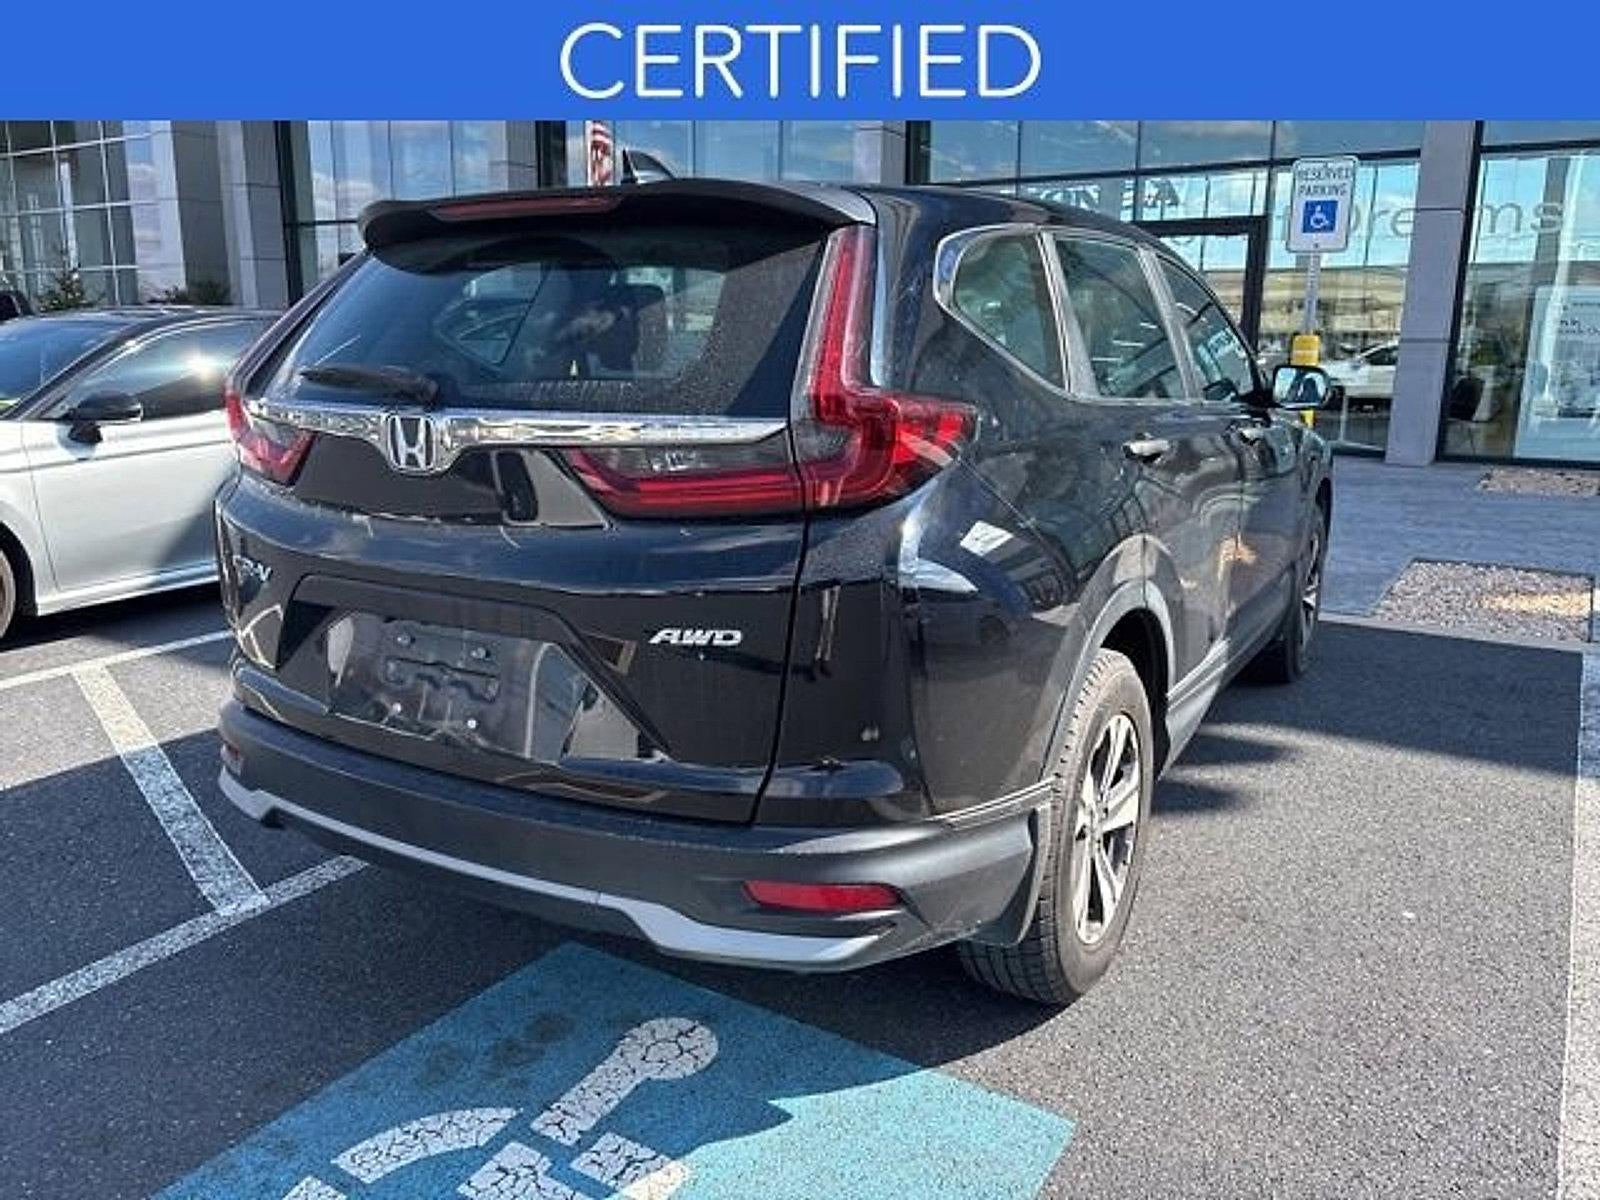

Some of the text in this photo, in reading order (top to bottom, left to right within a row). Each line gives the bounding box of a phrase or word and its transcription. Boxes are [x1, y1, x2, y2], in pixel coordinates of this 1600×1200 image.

[1298, 166, 1350, 181] RESERVED
[1299, 182, 1347, 196] PARKING
[648, 628, 743, 646] AWD
